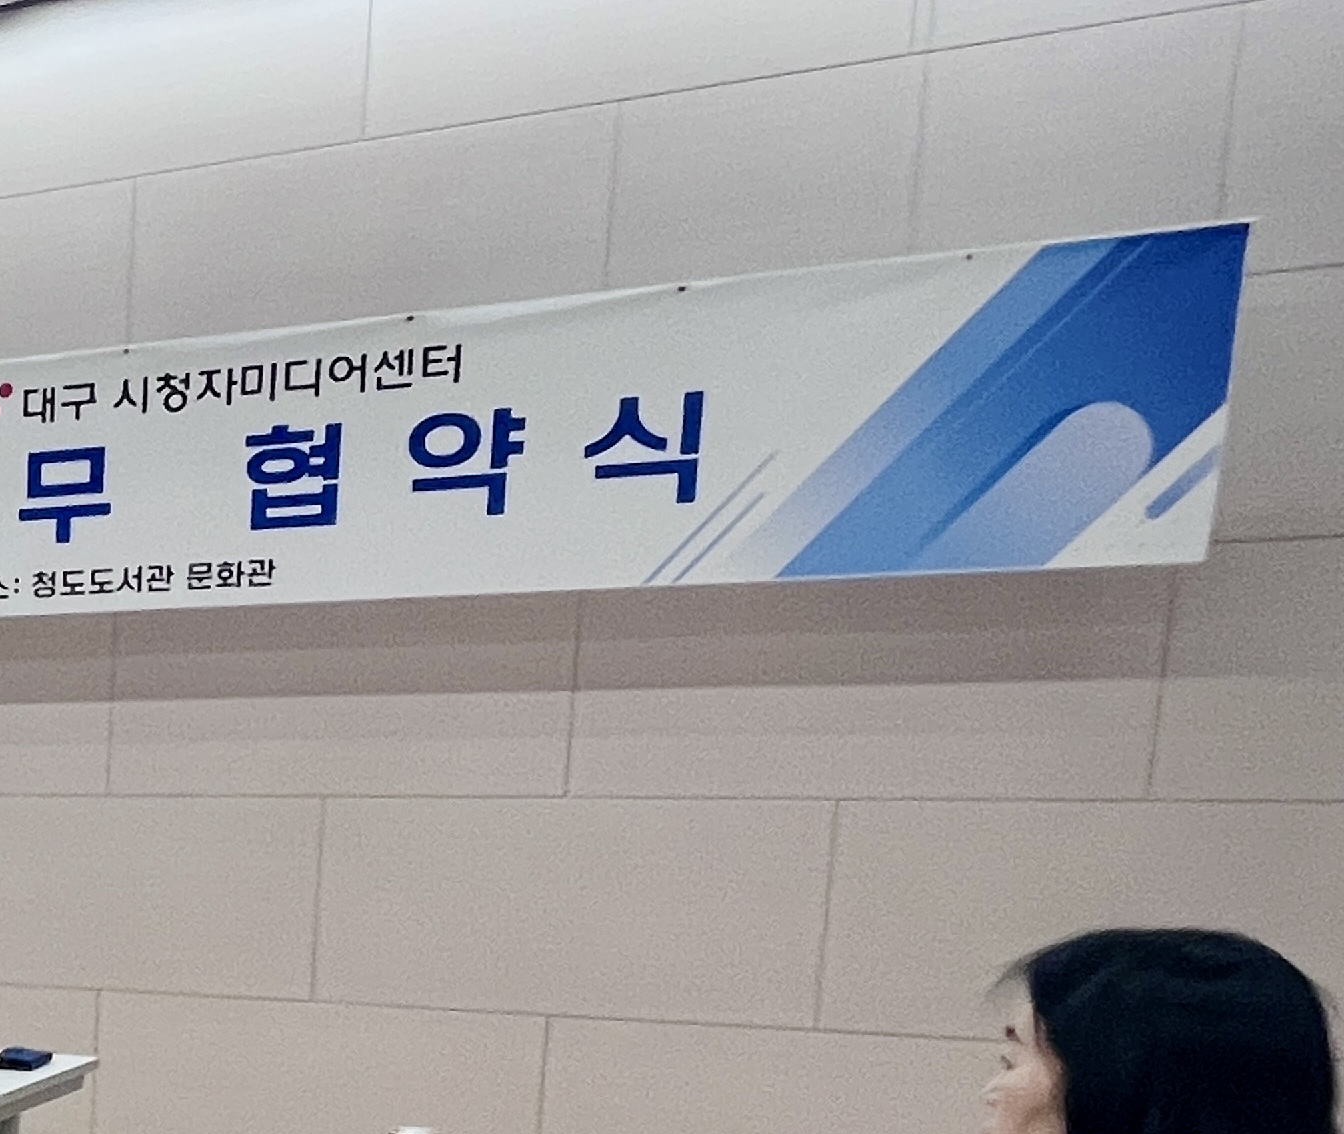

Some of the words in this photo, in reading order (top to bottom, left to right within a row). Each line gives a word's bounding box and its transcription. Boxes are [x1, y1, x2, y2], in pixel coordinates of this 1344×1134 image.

[22, 382, 98, 425] 대구
[112, 344, 464, 415] 시청자미디어센터
[244, 390, 707, 533] 협약식
[31, 564, 176, 599] 청도도서관
[186, 558, 277, 591] 문화관
